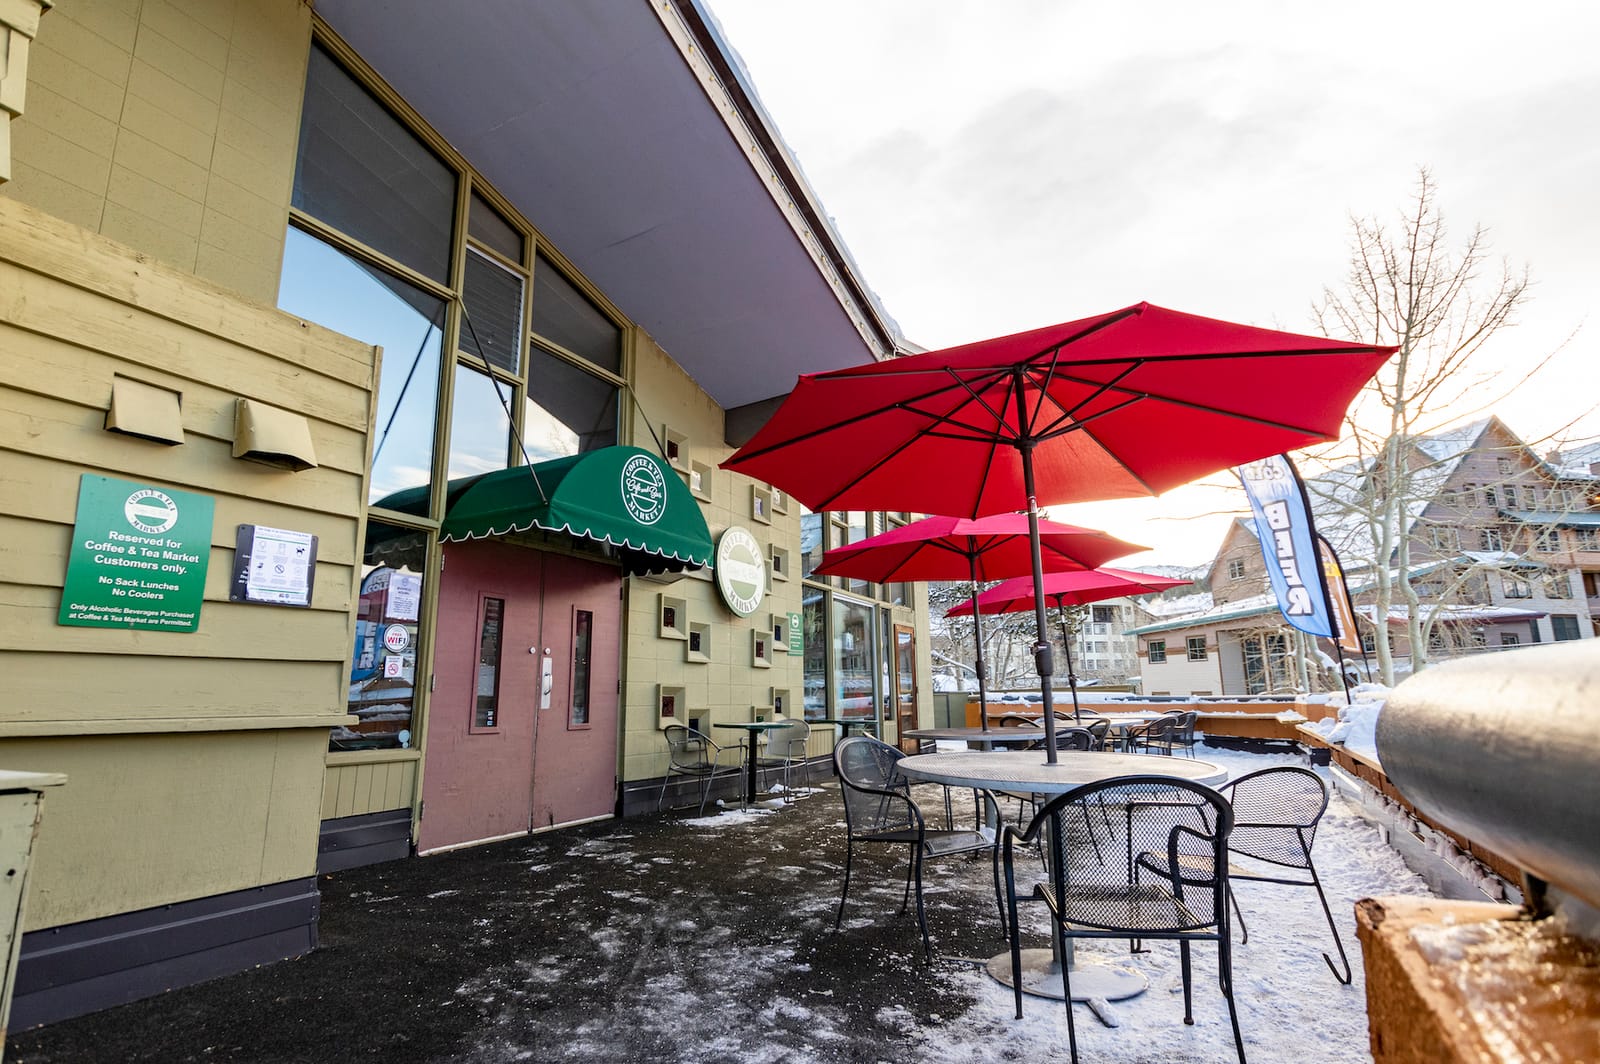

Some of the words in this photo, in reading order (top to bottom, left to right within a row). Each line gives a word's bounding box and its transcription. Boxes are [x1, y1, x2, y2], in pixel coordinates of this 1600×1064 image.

[626, 458, 648, 476] COFFEE
[653, 468, 663, 488] TEA
[128, 490, 154, 504] COFFEE
[164, 498, 176, 512] TEA
[628, 501, 659, 520] MARKET
[133, 520, 166, 533] MARKET
[108, 530, 163, 546] Reserved
[166, 540, 182, 549] for
[722, 533, 743, 560] COFFEE
[84, 540, 125, 554] Coffee
[128, 546, 136, 555] &
[140, 548, 160, 558] Tea
[162, 550, 200, 563] Market
[94, 554, 158, 570] Customers
[161, 563, 188, 574] only.
[98, 576, 113, 584] No
[115, 578, 138, 587] Sack
[140, 580, 180, 591] Lunches
[112, 588, 126, 596] No
[128, 590, 164, 600] Coolers
[729, 591, 759, 612] MARKET
[70, 604, 89, 612] Only
[88, 605, 122, 614] Alcoholic
[123, 608, 159, 617] Beverages
[160, 610, 194, 619] Purchased
[124, 616, 147, 624] Market
[387, 636, 406, 644] WIFI
